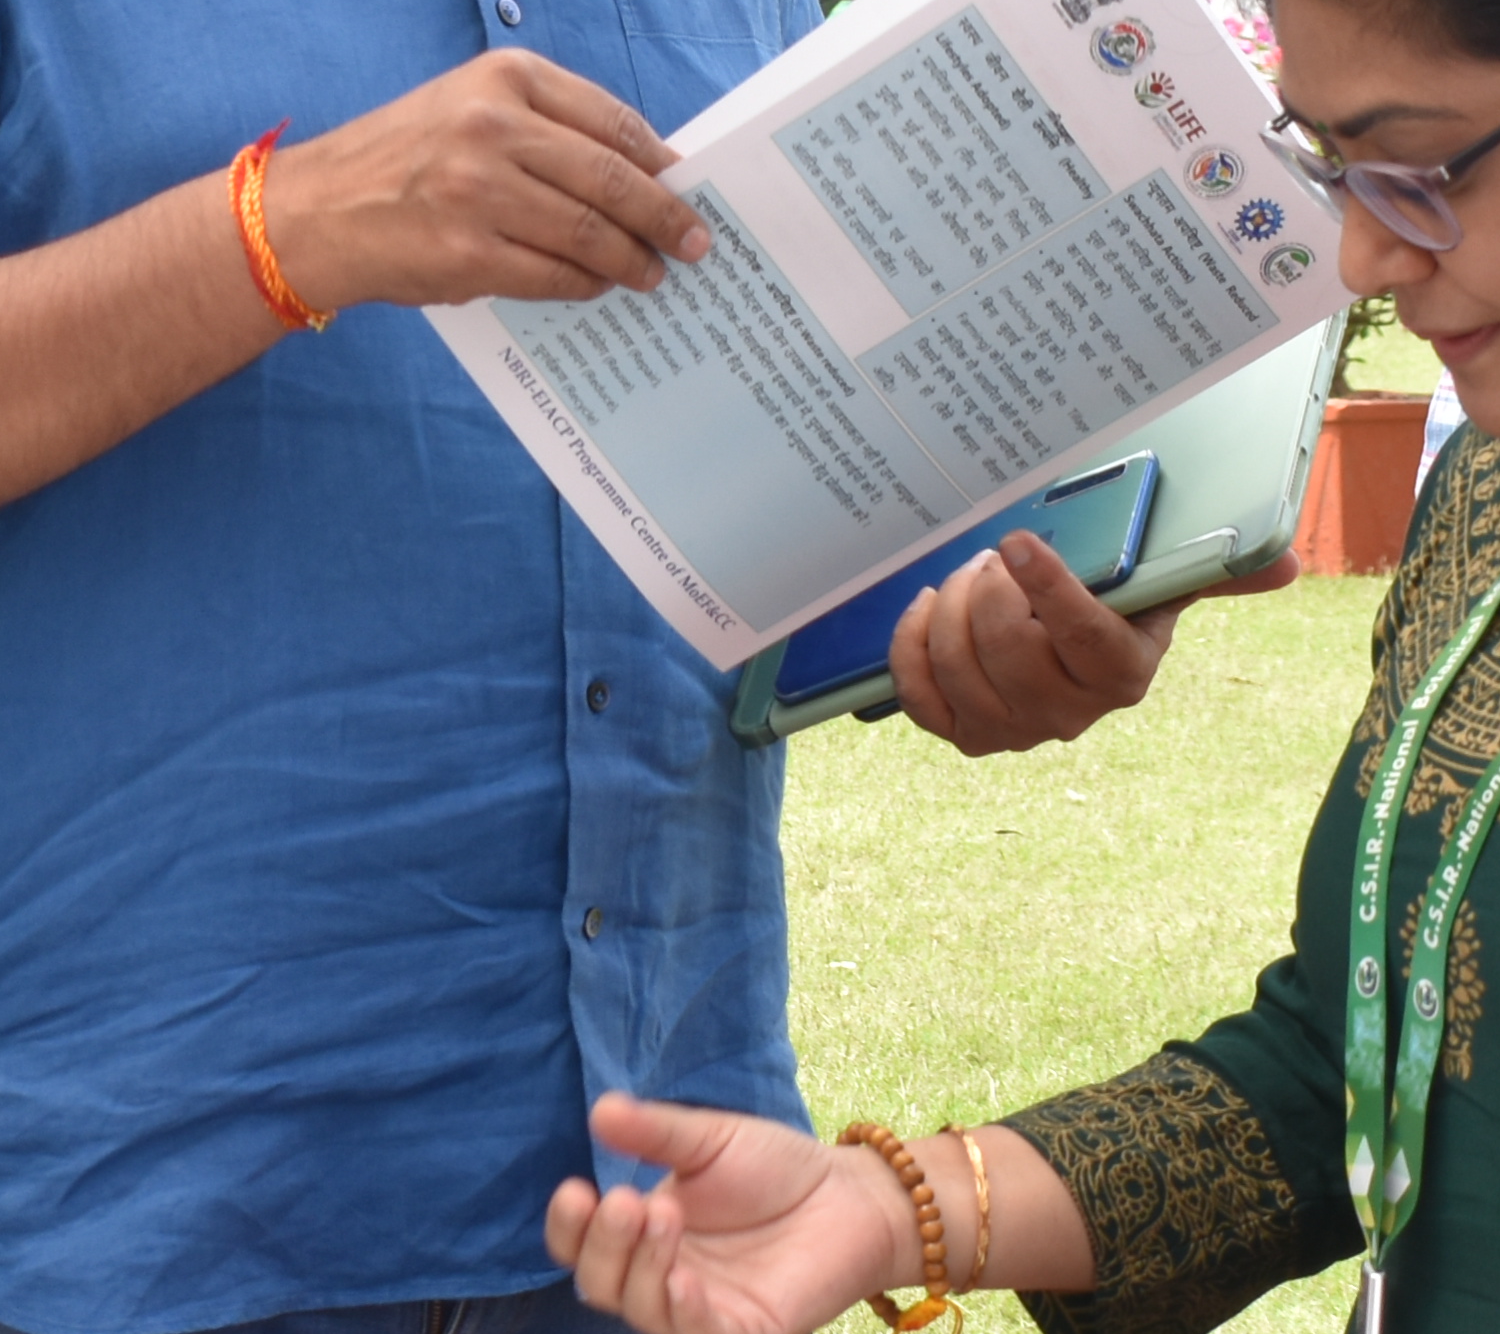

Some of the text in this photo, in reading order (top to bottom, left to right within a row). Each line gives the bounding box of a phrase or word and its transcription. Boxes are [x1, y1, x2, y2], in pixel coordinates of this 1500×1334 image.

[921, 54, 954, 93] प्राथमिक
[971, 122, 999, 155] उपचार
[993, 151, 1011, 173] हेतु
[935, 31, 1011, 130] Lifestyles Adopted)
[958, 15, 1094, 199] स्वस्थ जीवन शैली (Healthy
[1167, 98, 1207, 142] LiFE
[819, 176, 846, 209] परिवेश
[832, 151, 946, 295] जनित उपकरणों एवं का
[842, 206, 856, 219] में
[848, 216, 878, 249] उपयोग
[906, 166, 928, 189] आदि
[925, 188, 945, 208] जैसे
[973, 209, 994, 230] करी
[1066, 242, 1082, 258] का
[1075, 255, 1099, 281] प्रयोग
[1085, 228, 1181, 343] पूसा जैसी वैज्ञानिक
[1106, 215, 1130, 237] कृषि
[1125, 237, 1154, 270] अपशिष्ट
[1150, 267, 1169, 286] जैसे
[1181, 306, 1194, 319] के
[1123, 193, 1195, 284] Swachhata Actions)
[1146, 178, 1259, 322] न्यूनतम अपशिष्ट (Waste Reduced
[1275, 253, 1302, 284] NBRI
[695, 189, 724, 224] न्यूनतम
[765, 281, 797, 318] अपशिष्ट
[789, 317, 824, 358] (E-Waste
[821, 357, 856, 397] reduced)
[956, 311, 991, 352] Farming)
[988, 349, 1005, 364] को
[978, 295, 999, 318] बिना
[995, 321, 1024, 347] जुताई
[1020, 348, 1037, 363] की
[1033, 365, 1055, 385] खेती
[998, 284, 1040, 332] (mulching)
[1035, 328, 1053, 348] हेतु
[1021, 269, 1113, 381] प्रयोग खाद और
[1041, 256, 1064, 277] कृषि
[1088, 311, 1104, 331] पशु
[1101, 328, 1123, 353] जनित
[1120, 354, 1147, 383] अपशिष्ट
[703, 321, 732, 356] अपशिष्ट
[726, 353, 744, 373] हेतु
[774, 413, 789, 429] का
[811, 462, 829, 481] हेतु
[758, 311, 775, 328] एवं
[769, 325, 789, 348] जिन
[784, 346, 821, 387] उपकरणों
[814, 385, 832, 400] की
[872, 456, 887, 468] है
[893, 350, 954, 420] उपयोग हो (जैसे
[932, 363, 955, 384] कृषि
[950, 381, 968, 398] एवं
[963, 395, 979, 415] पशु
[975, 411, 997, 434] जनित
[993, 434, 1019, 461] अपशिष्ट
[1015, 458, 1029, 470] का
[935, 323, 1028, 431] प्राकृतिक आधारित खेती को
[497, 346, 736, 630] NBRI-EIACP Programme Centre of MoEF&CC
[860, 480, 876, 494] को
[1410, 614, 1486, 711] Botanical
